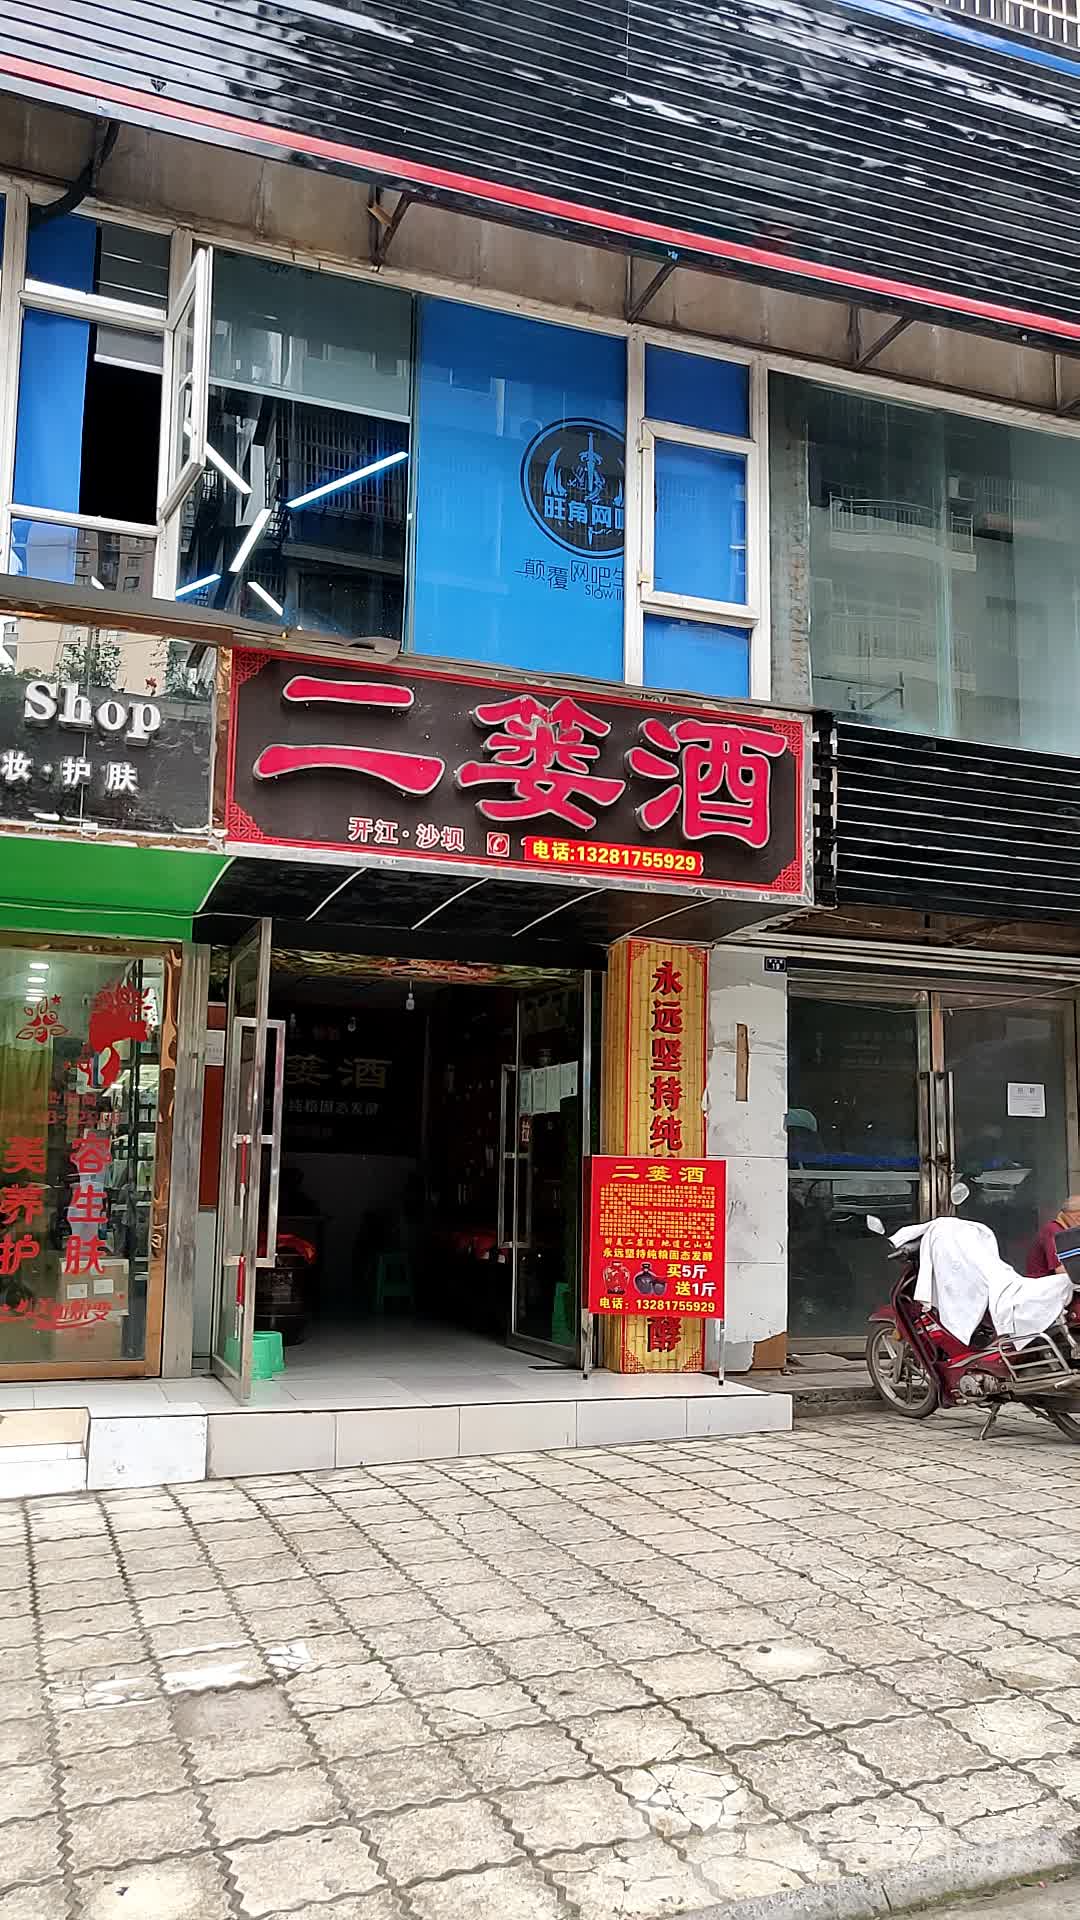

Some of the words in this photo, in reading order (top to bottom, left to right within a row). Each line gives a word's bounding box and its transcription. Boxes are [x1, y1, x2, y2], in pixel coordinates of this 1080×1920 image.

[24, 680, 161, 742] Shop
[650, 960, 683, 1157] 永远坚持纯
[666, 1263, 707, 1280] 买5斤
[675, 1281, 717, 1297] 送1斤
